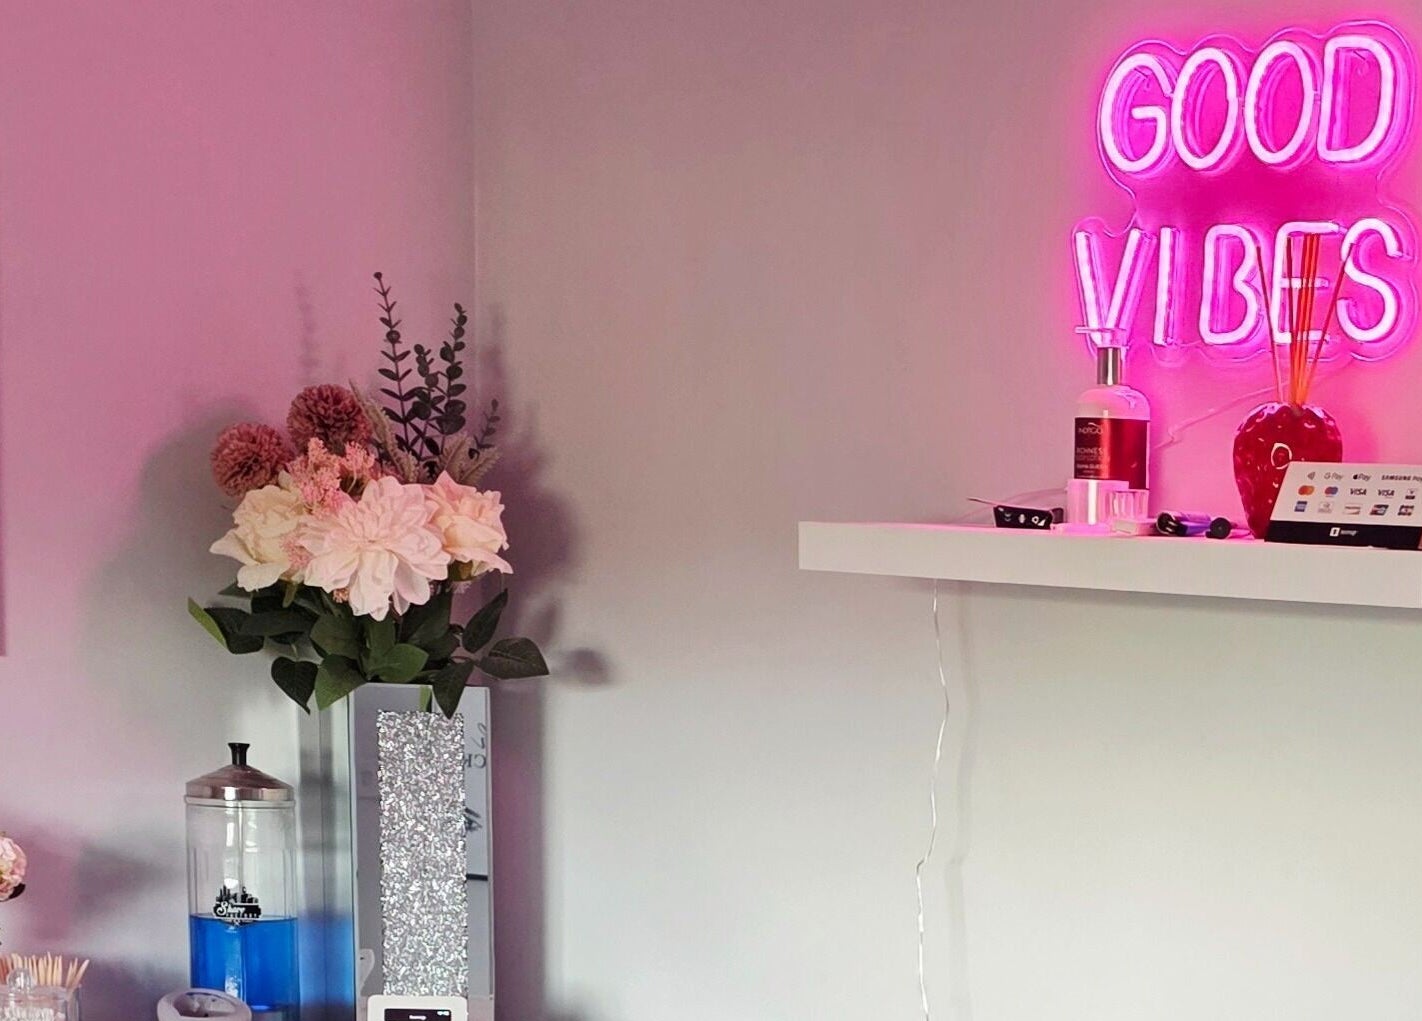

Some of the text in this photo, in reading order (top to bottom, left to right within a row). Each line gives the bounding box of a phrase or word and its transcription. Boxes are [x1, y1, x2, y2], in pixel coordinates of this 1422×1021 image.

[1099, 35, 1398, 173] GOOD
[1074, 218, 1404, 346] VIBES
[1350, 488, 1367, 496] VISA
[1378, 489, 1395, 497] VISA
